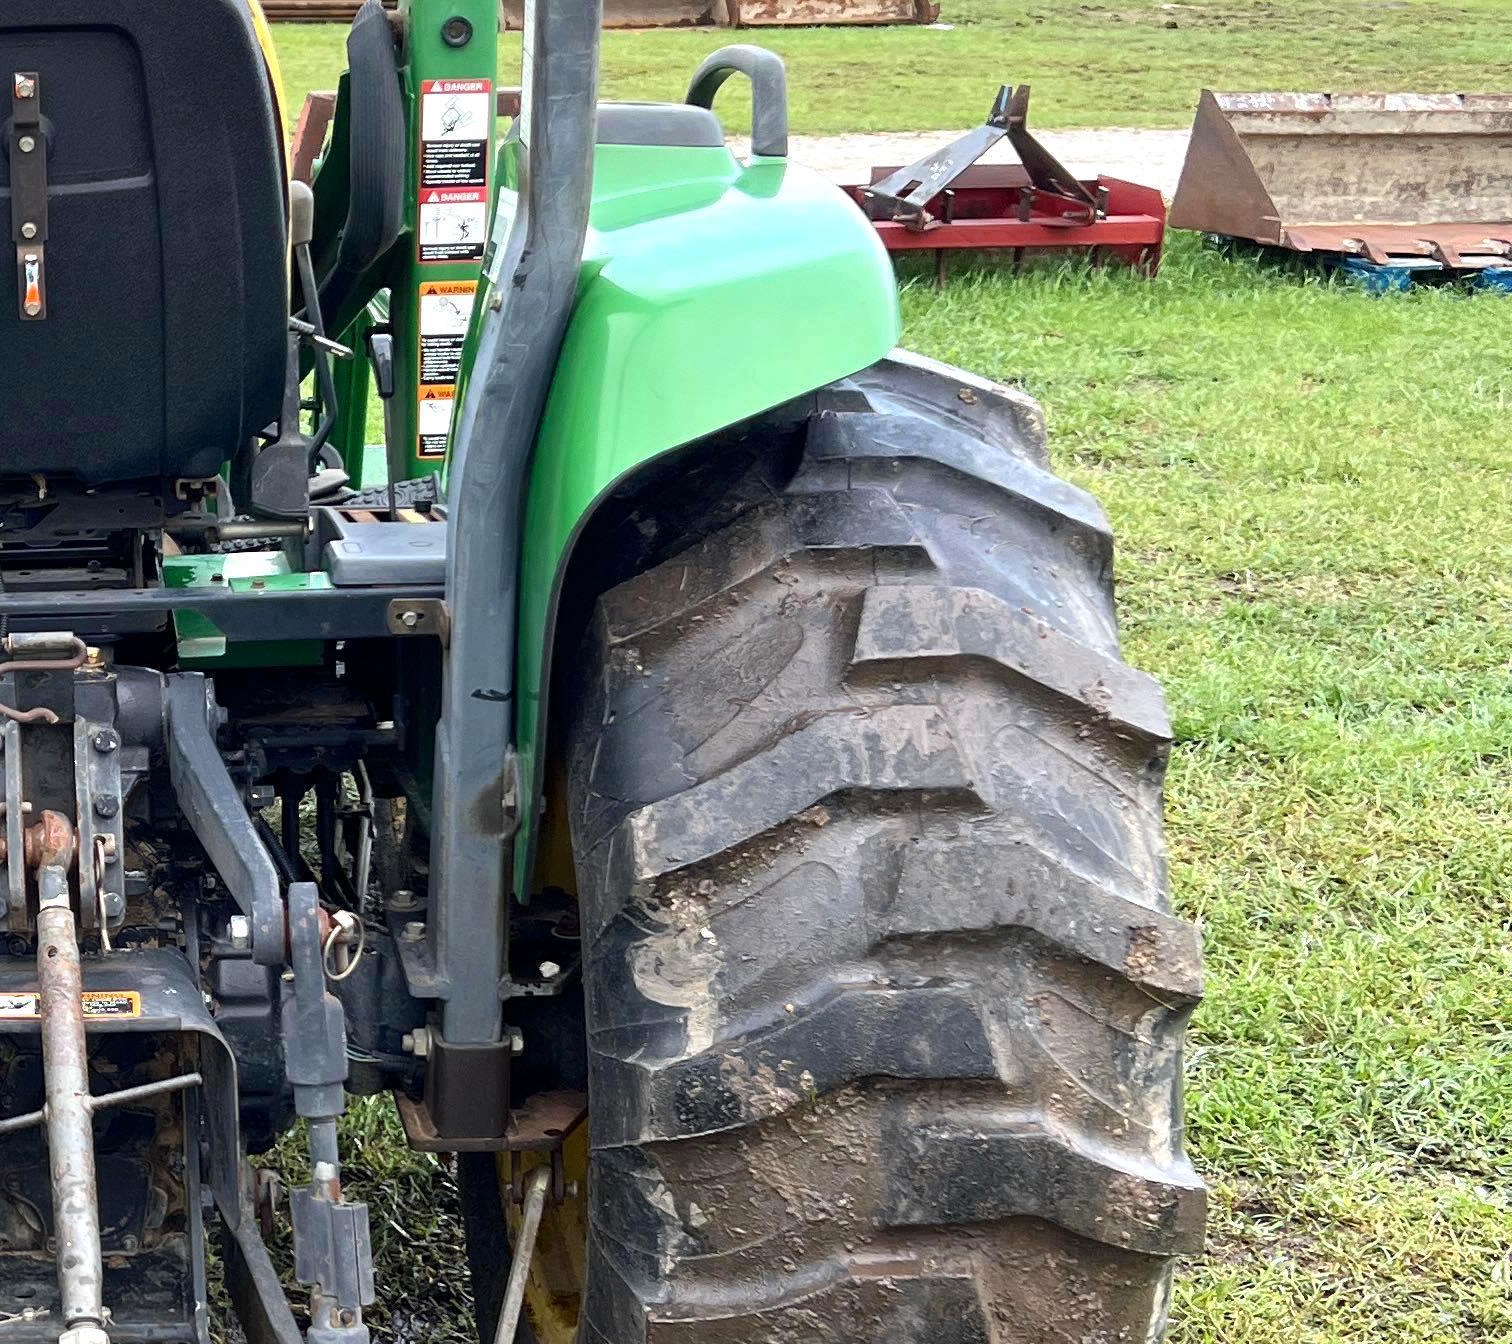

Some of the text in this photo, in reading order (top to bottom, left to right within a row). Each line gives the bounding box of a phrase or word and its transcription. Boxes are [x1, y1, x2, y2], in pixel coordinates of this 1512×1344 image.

[444, 82, 483, 91] DANGER
[440, 192, 480, 201] DANGER
[439, 286, 475, 294] WARNIN
